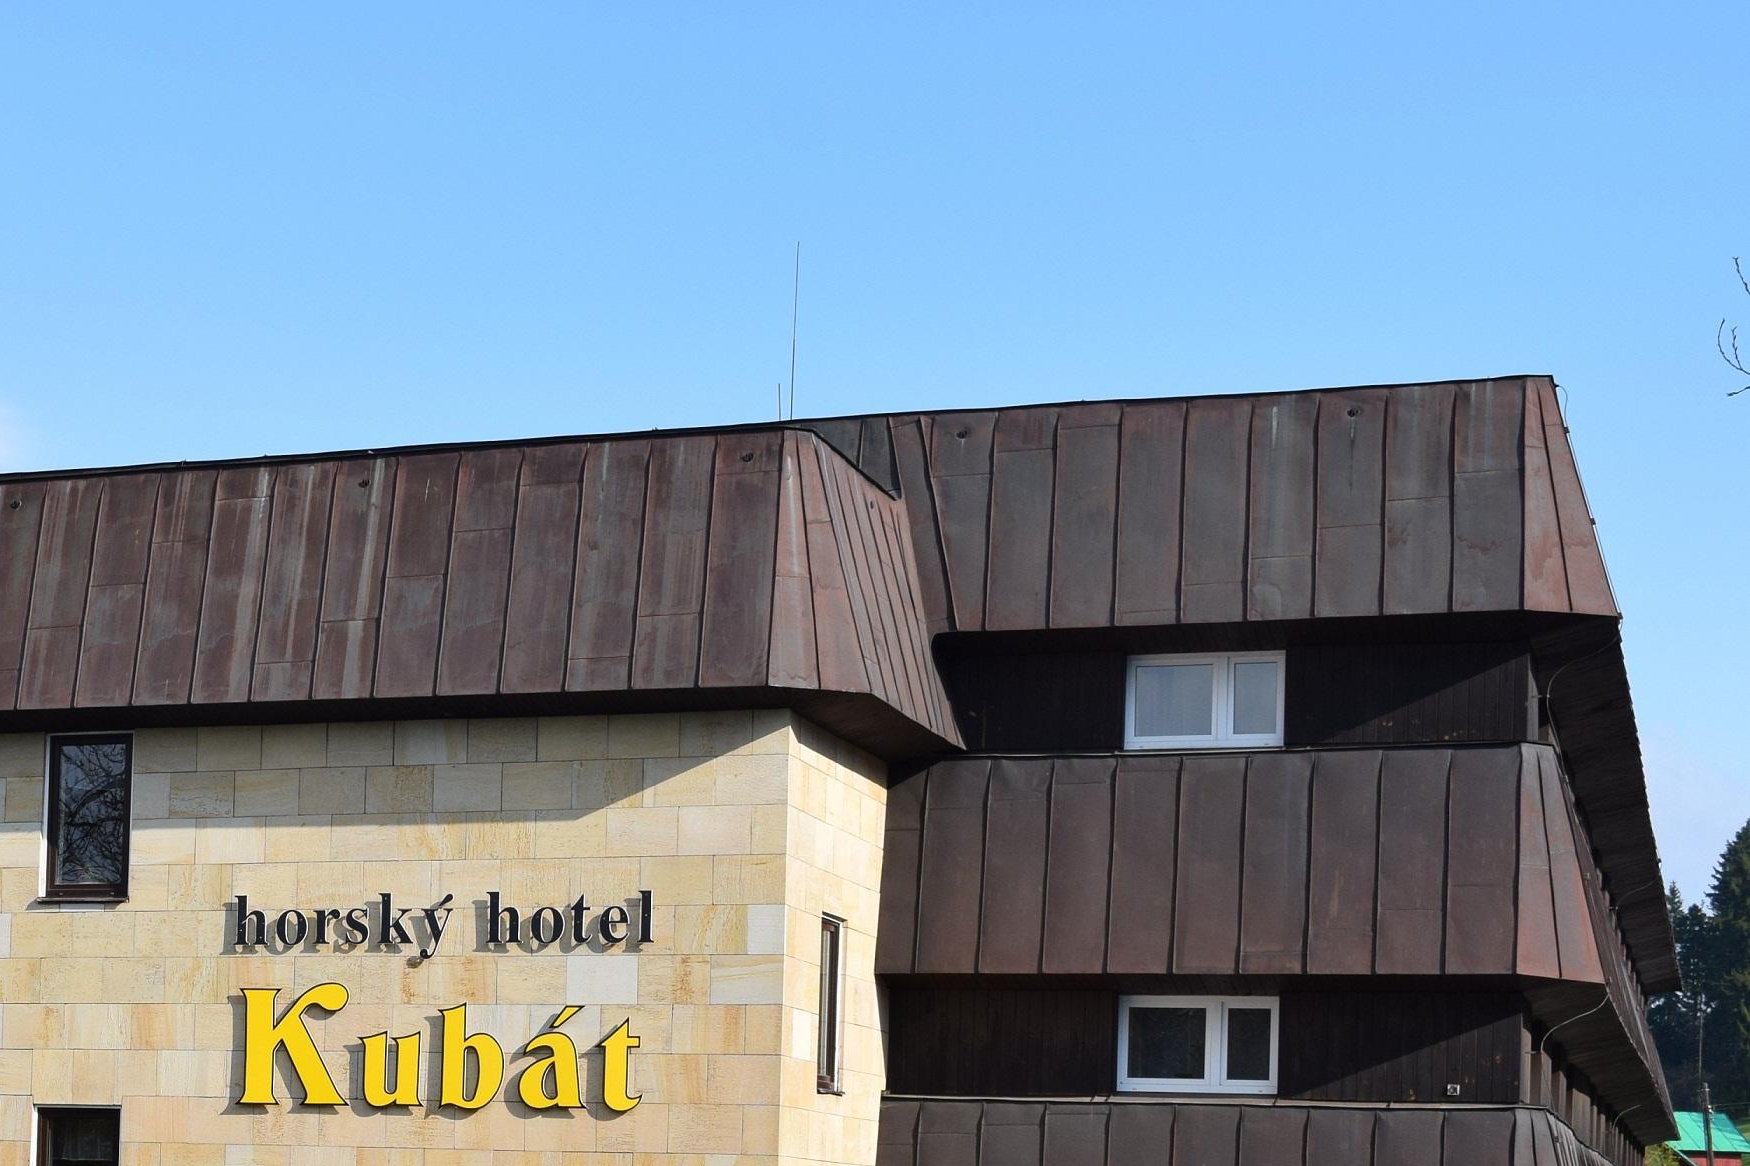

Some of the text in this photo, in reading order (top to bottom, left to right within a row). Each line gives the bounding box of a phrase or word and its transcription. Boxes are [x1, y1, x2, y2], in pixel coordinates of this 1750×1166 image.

[231, 889, 655, 960] horský hotel
[238, 982, 643, 1112] Kubát
